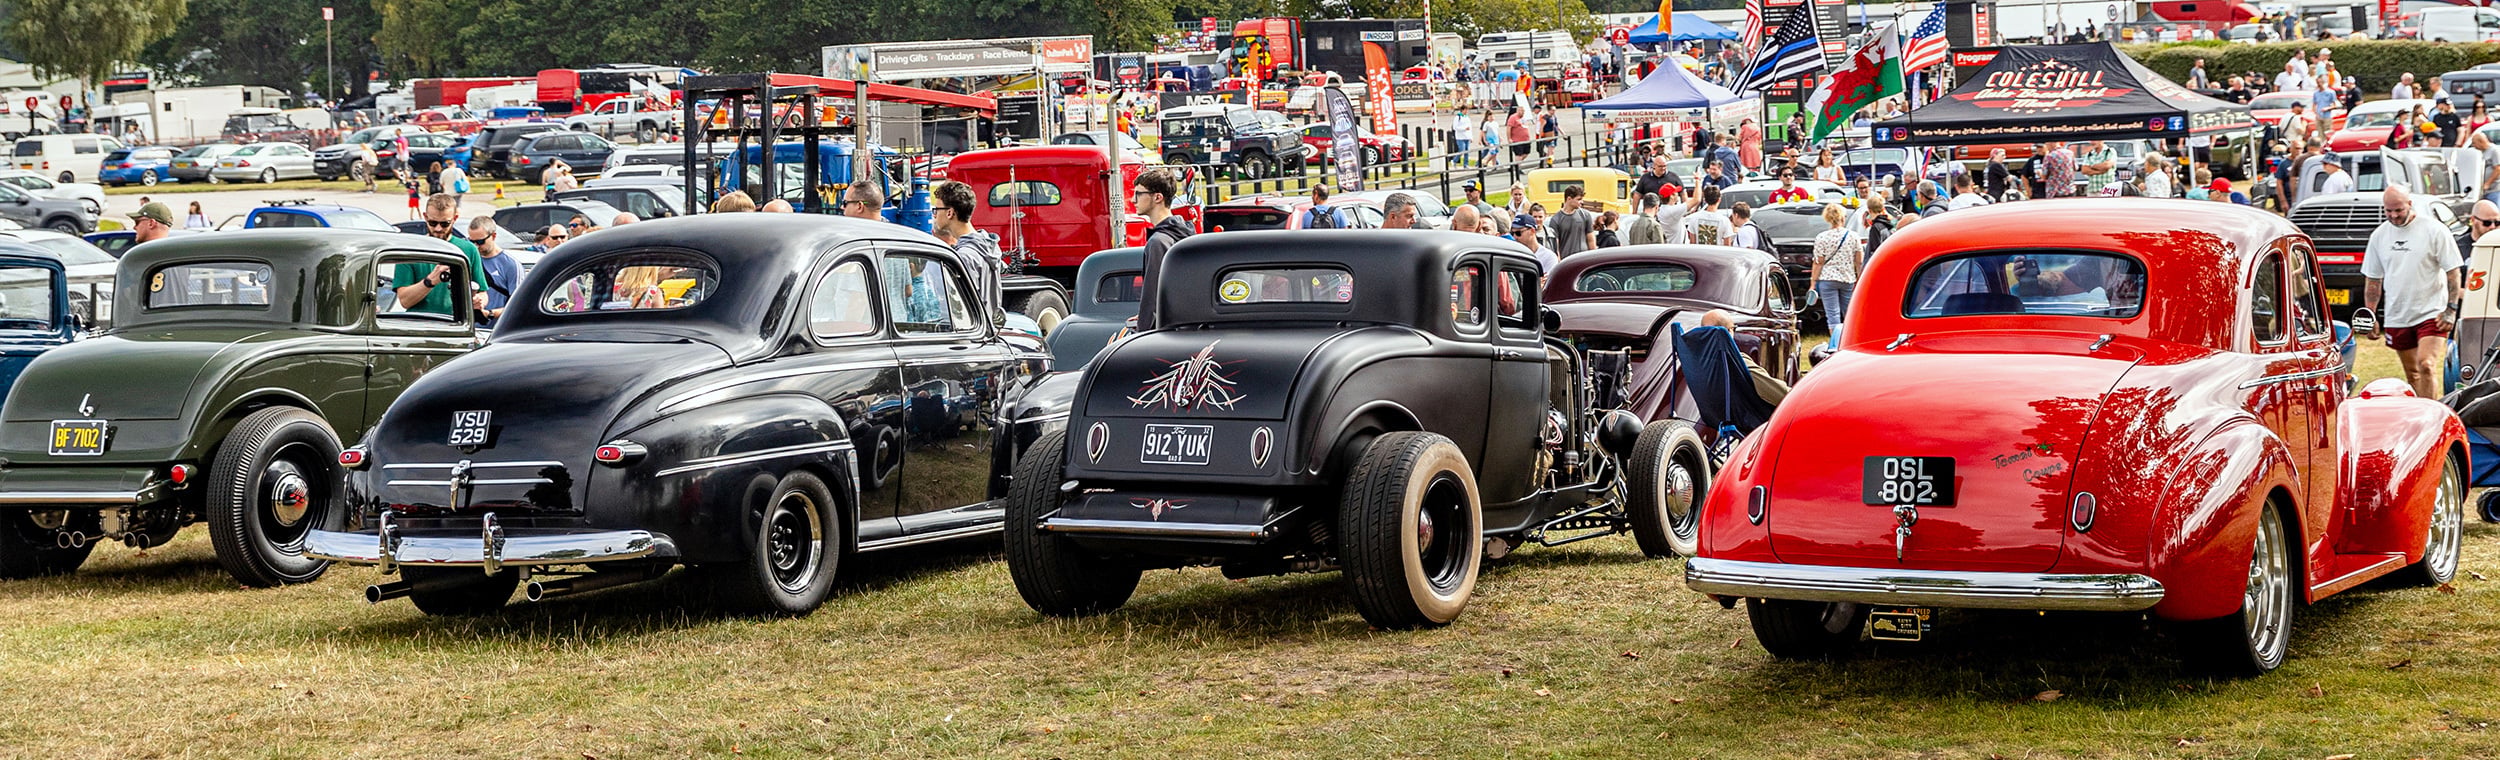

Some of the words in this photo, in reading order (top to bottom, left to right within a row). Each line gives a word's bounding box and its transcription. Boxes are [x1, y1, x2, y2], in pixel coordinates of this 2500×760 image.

[879, 54, 908, 65] Driving
[909, 54, 928, 63] Gifts
[936, 53, 975, 63] Trackdays
[983, 51, 1002, 59] Race
[1003, 50, 1029, 59] Events
[1986, 70, 2105, 88] COLESHILL
[1391, 86, 1423, 95] ODGE
[1973, 88, 2016, 99] Auto
[2017, 87, 2109, 100] Breakfast
[1185, 94, 1233, 106] MSVT
[150, 272, 165, 292] 8
[455, 411, 488, 428] VSU
[55, 428, 72, 448] BF
[73, 428, 100, 448] 7102
[450, 428, 485, 444] 529
[1145, 433, 1172, 456] 912
[1177, 434, 1209, 457] YUK
[1883, 458, 1934, 480] OSL
[2023, 462, 2062, 482] Coupe
[1882, 480, 1933, 503] 802
